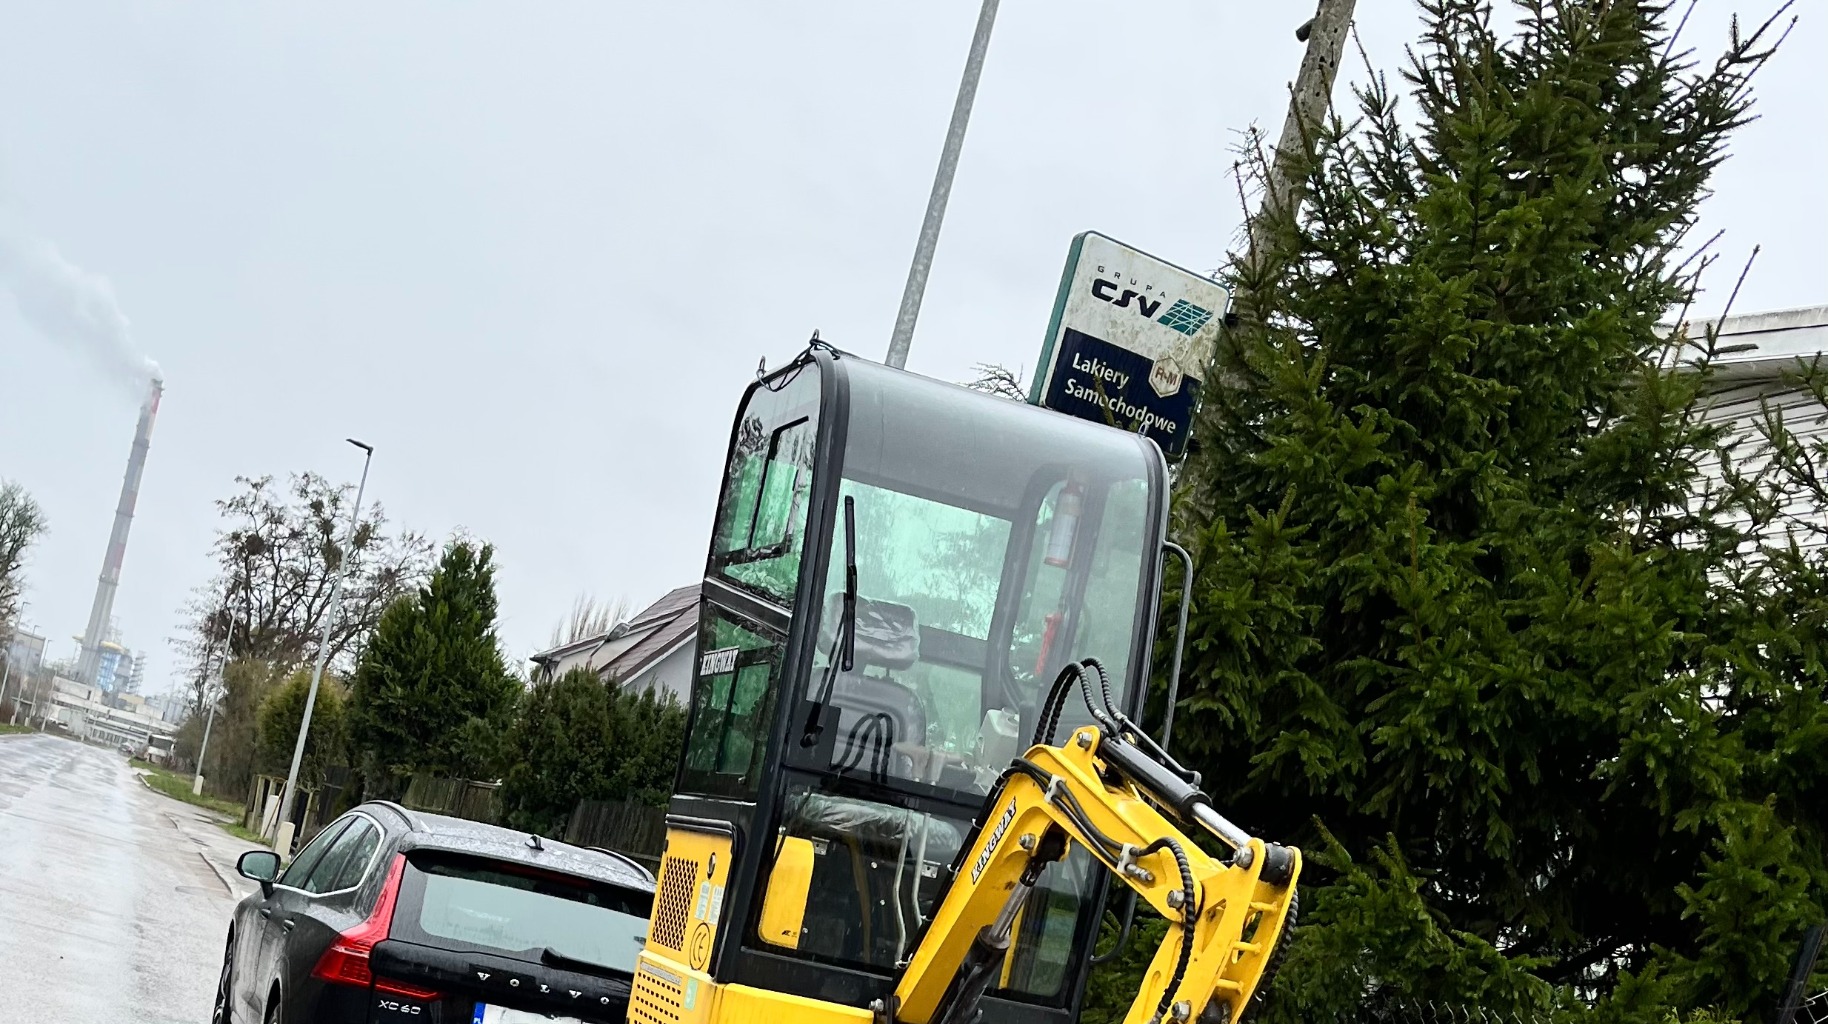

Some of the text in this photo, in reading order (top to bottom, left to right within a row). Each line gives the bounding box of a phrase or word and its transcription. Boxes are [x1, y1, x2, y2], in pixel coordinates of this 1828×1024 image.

[1091, 278, 1162, 319] CSV
[1097, 265, 1166, 298] GRUPA
[1072, 352, 1130, 390] Lakiery
[971, 797, 1016, 884] KINGWAY
[476, 971, 610, 1005] VOLVO
